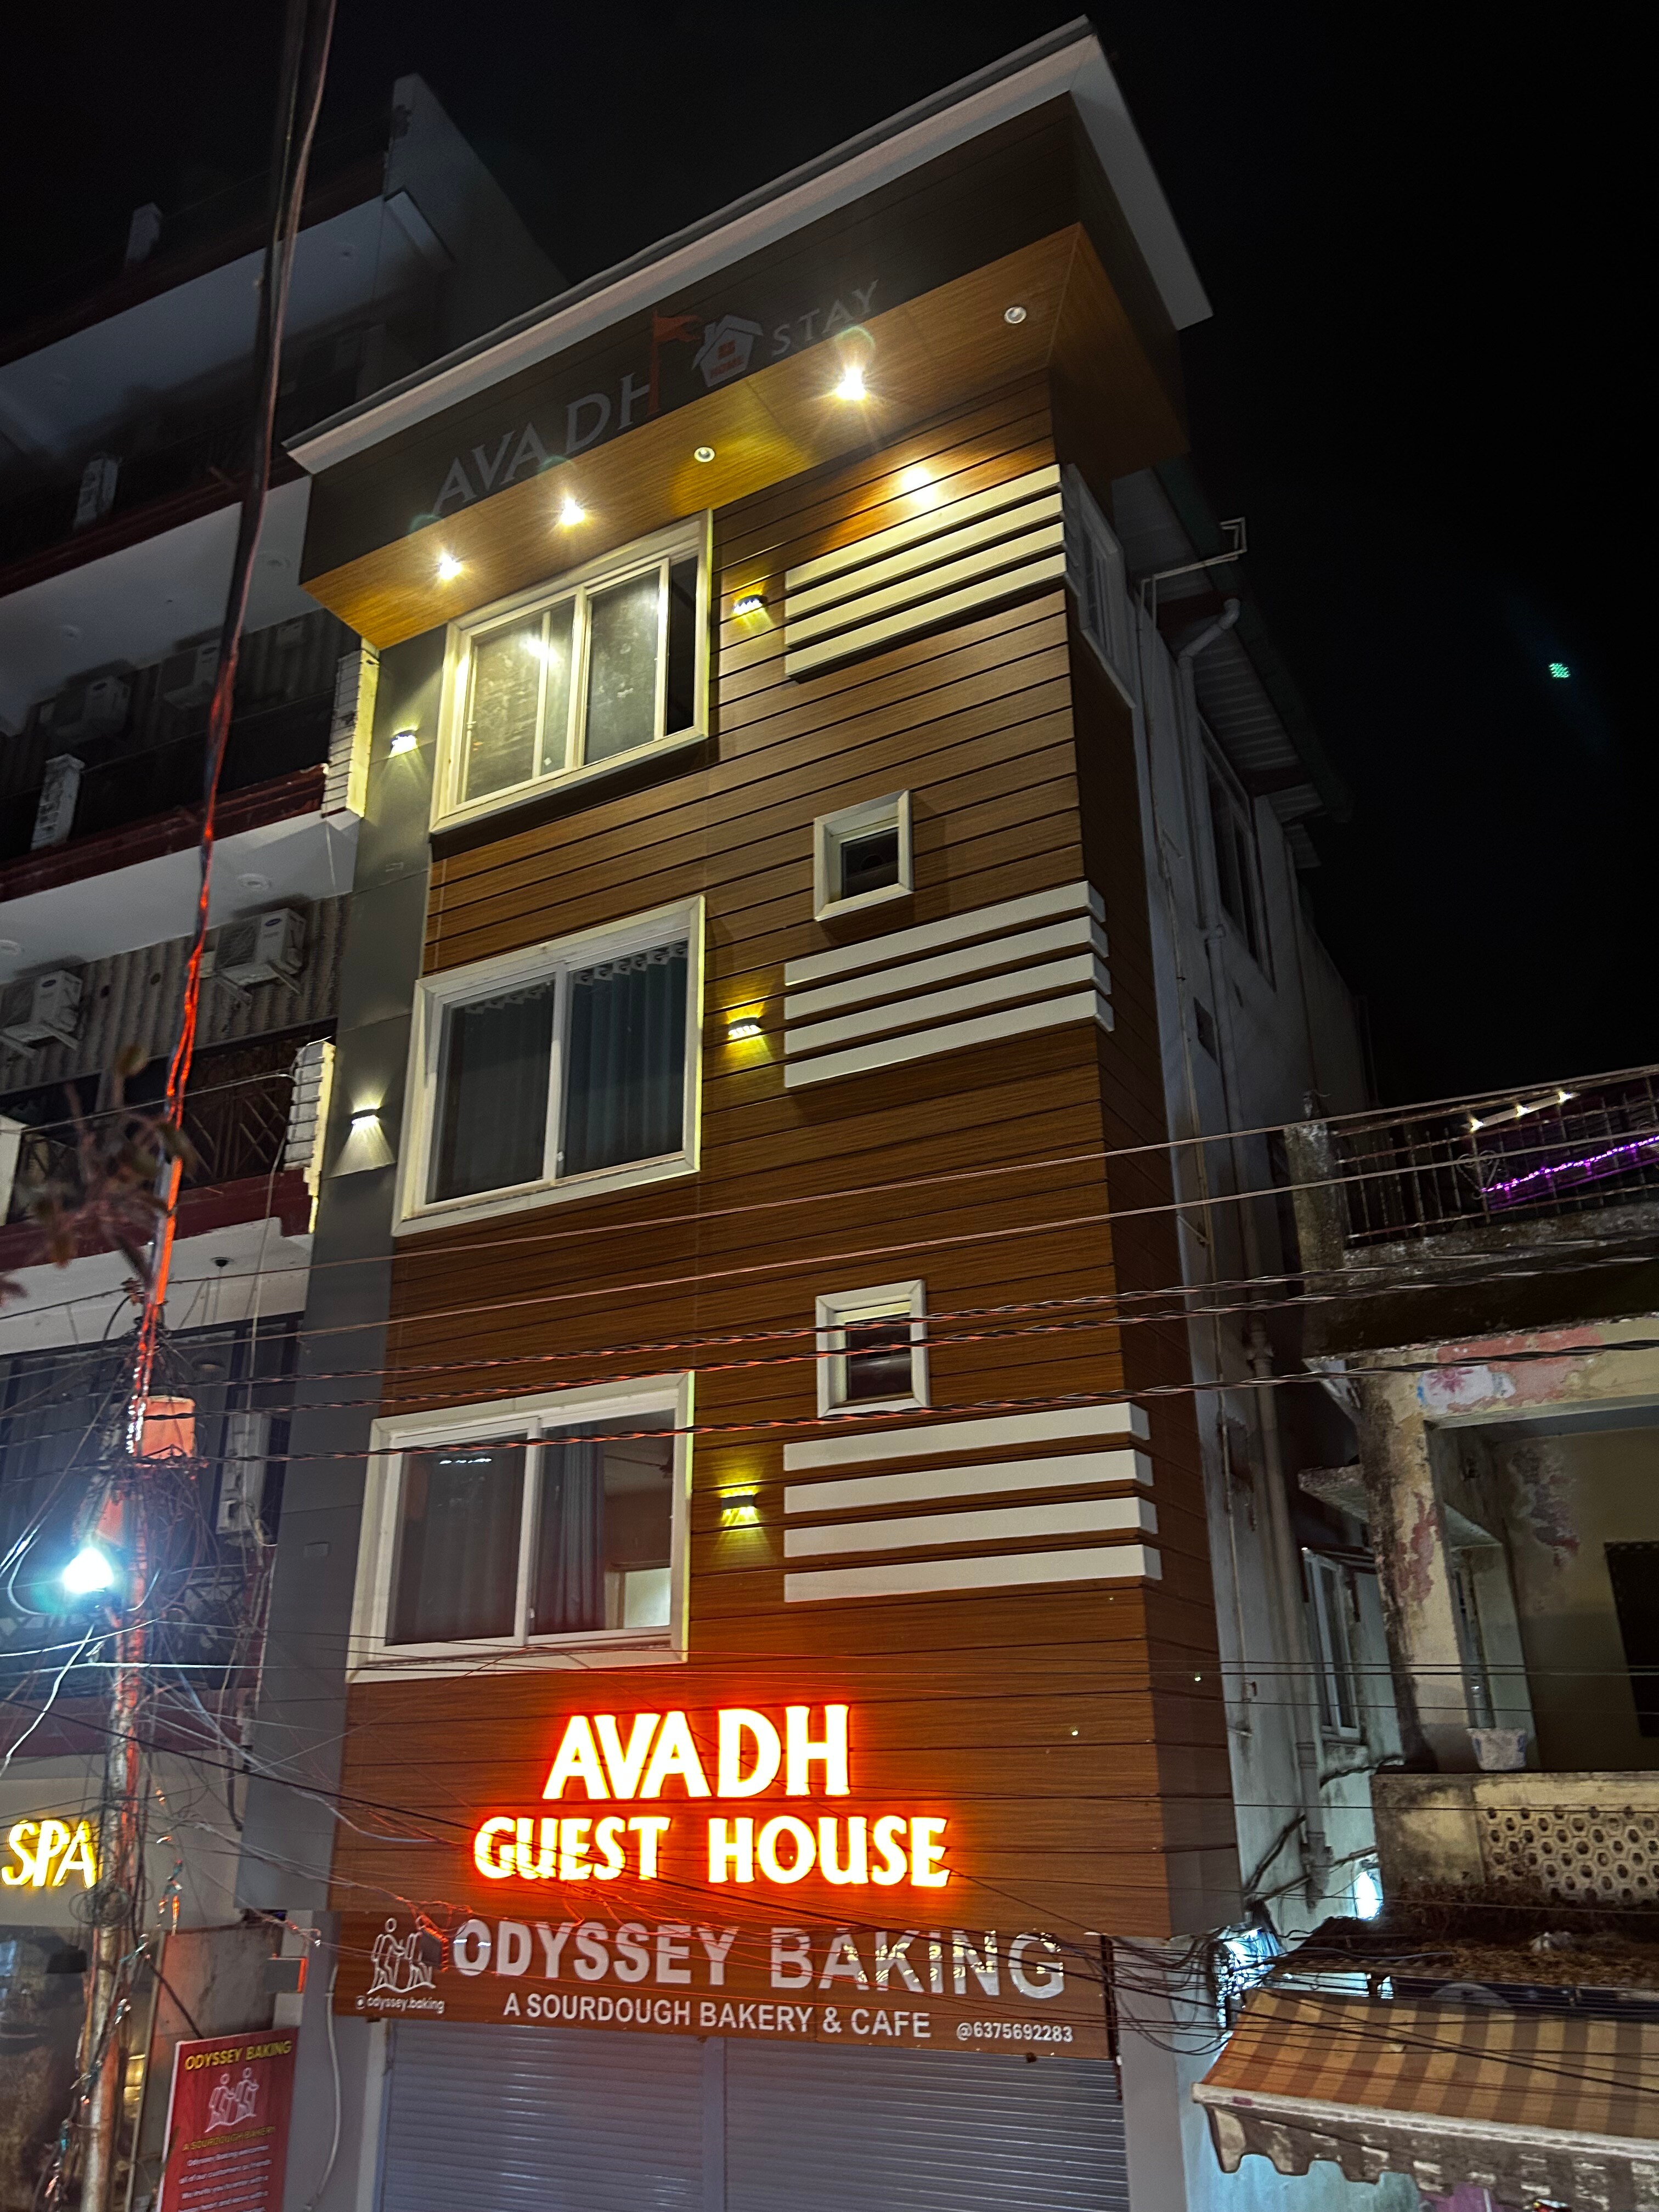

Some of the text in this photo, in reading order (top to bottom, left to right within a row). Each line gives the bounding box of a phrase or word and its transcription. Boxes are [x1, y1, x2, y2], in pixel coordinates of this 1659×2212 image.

[432, 366, 658, 517] AVADH
[771, 280, 878, 357] STAY
[542, 1704, 851, 1799] AVADH
[1, 1819, 98, 1889] SPA
[475, 1815, 951, 1888] GUEST HOUSE
[453, 1919, 1065, 1999] ODYSSEY BAKING
[503, 1992, 1074, 2042] A SOURDOUGH BAKERY & CAFE @6375692283
[185, 2040, 292, 2070] ODYSSEY BAKING
